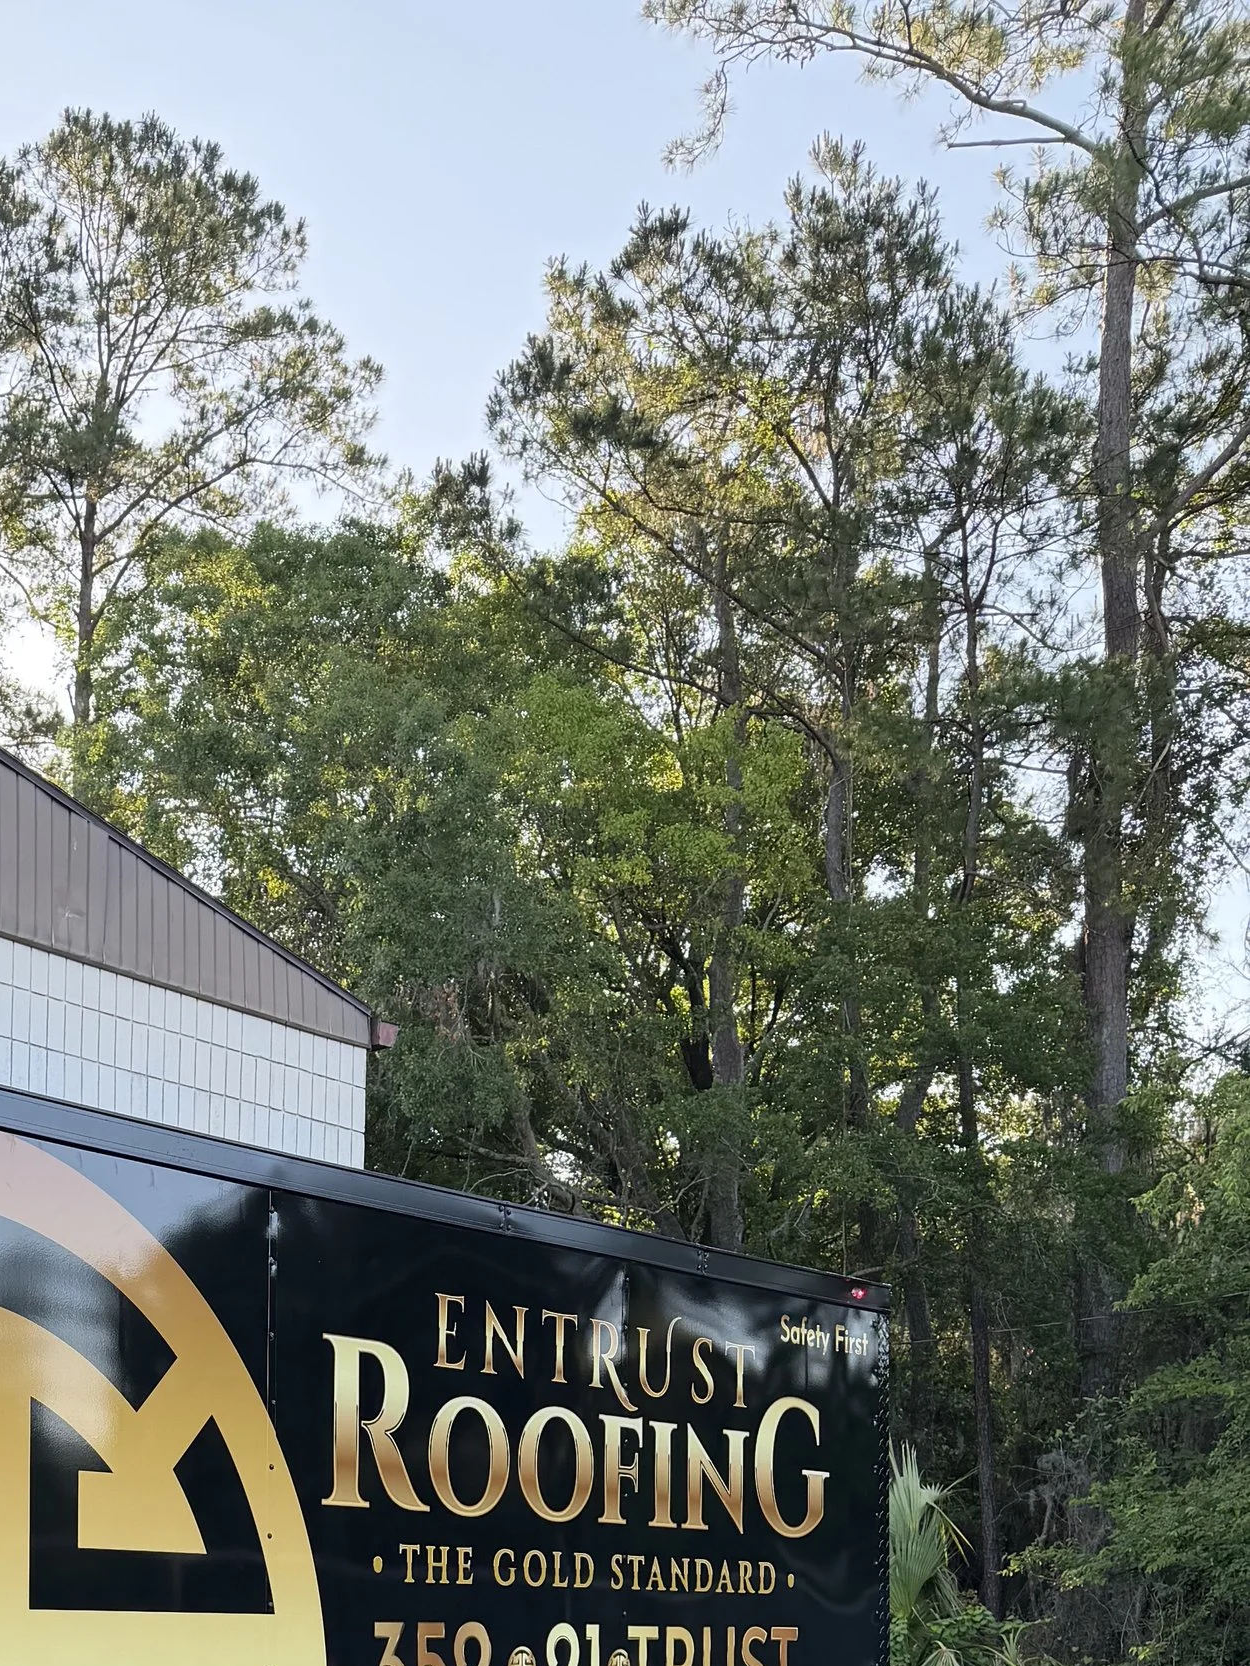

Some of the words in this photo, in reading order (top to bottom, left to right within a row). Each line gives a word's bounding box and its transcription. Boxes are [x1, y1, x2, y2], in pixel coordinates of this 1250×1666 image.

[434, 1292, 755, 1412] ENTRUST
[780, 1314, 830, 1356] Safety
[835, 1324, 869, 1356] First
[321, 1333, 830, 1539] ROOFING
[399, 1544, 474, 1585] THE
[493, 1548, 594, 1590] GOLD
[610, 1554, 777, 1595] STANDARD
